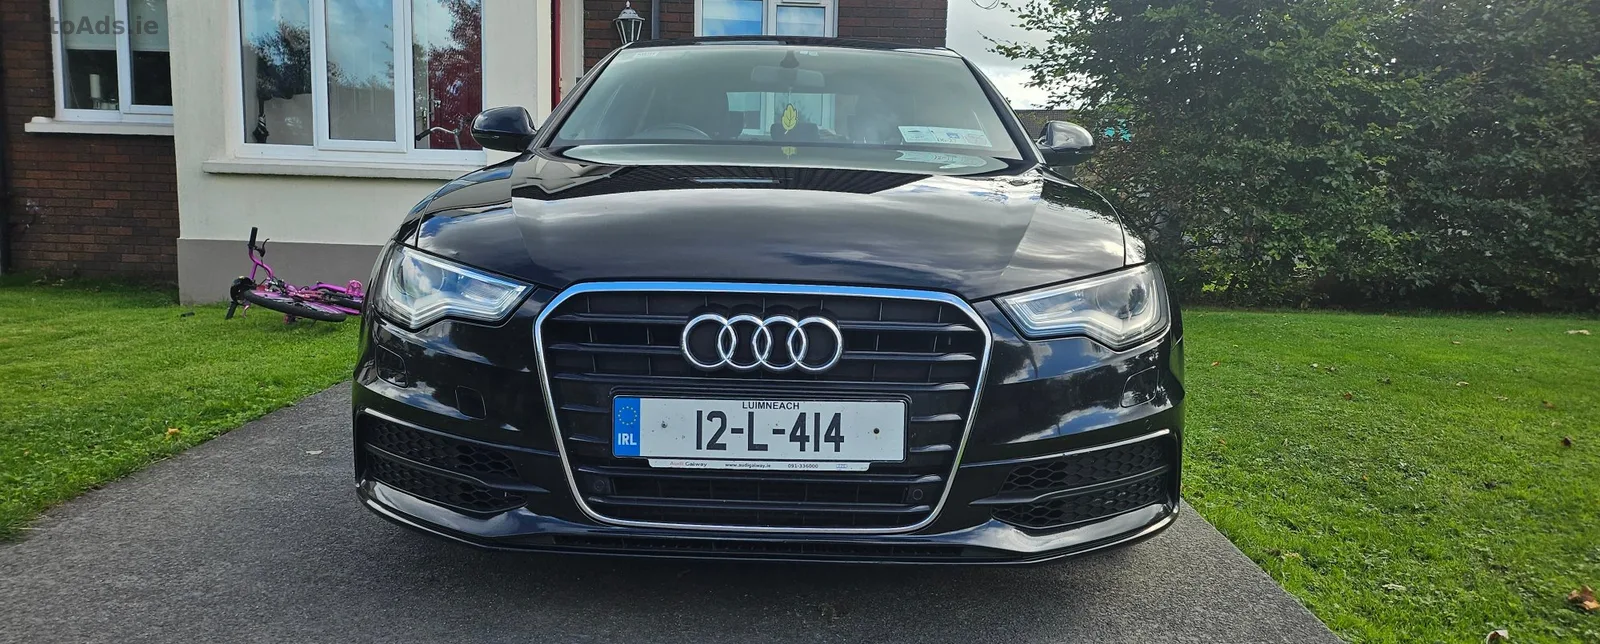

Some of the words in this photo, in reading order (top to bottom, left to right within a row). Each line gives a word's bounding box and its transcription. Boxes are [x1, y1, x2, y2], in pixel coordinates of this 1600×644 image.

[742, 401, 800, 409] LUIMNEACH
[696, 410, 845, 452] 12-L-414
[617, 433, 637, 446] IRL
